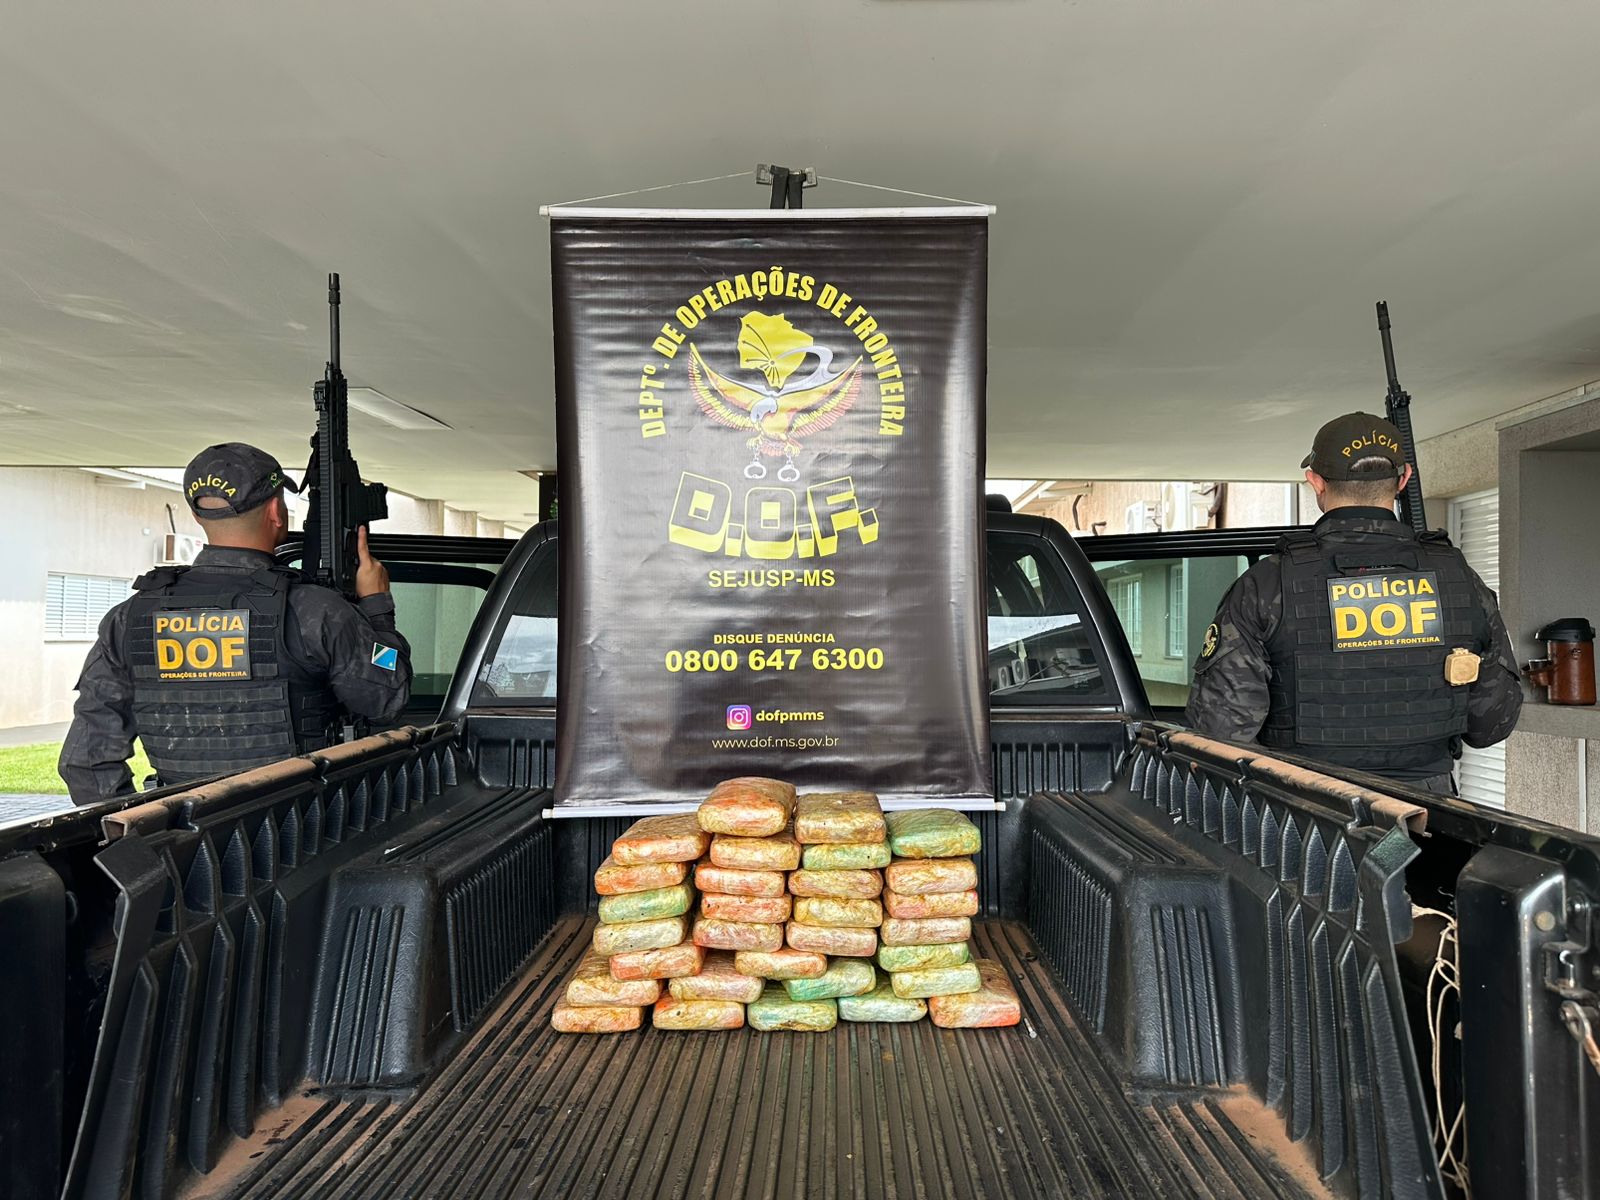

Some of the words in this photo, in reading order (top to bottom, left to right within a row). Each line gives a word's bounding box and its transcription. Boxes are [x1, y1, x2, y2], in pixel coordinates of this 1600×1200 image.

[651, 322, 687, 359] DE
[675, 265, 815, 329] OPERAÇÕES
[816, 283, 852, 318] DE
[844, 304, 906, 436] FRONTEIRA
[1341, 429, 1399, 457] POLÍCIA
[188, 474, 236, 497] POLÍCIA
[669, 471, 879, 559] D.O.F.
[708, 569, 836, 588] SEJUSP-MS
[1332, 577, 1434, 602] POLÍCIA
[156, 612, 245, 634] POLÍCIA
[1334, 600, 1437, 640] DOF
[713, 633, 764, 645] DISQUE
[767, 630, 836, 644] DENÚNCIA
[1337, 638, 1383, 649] OPERAÇÕES
[1384, 638, 1395, 646] DE
[1396, 636, 1440, 645] FRONTEIRA
[157, 636, 246, 670] DOF
[664, 650, 738, 672] 0800
[748, 649, 802, 671] 647
[812, 648, 884, 670] 6300
[208, 670, 247, 678] FRONTEIRA
[755, 708, 825, 723] dofpmms
[711, 735, 840, 749] www.dof.ms.gov.br
